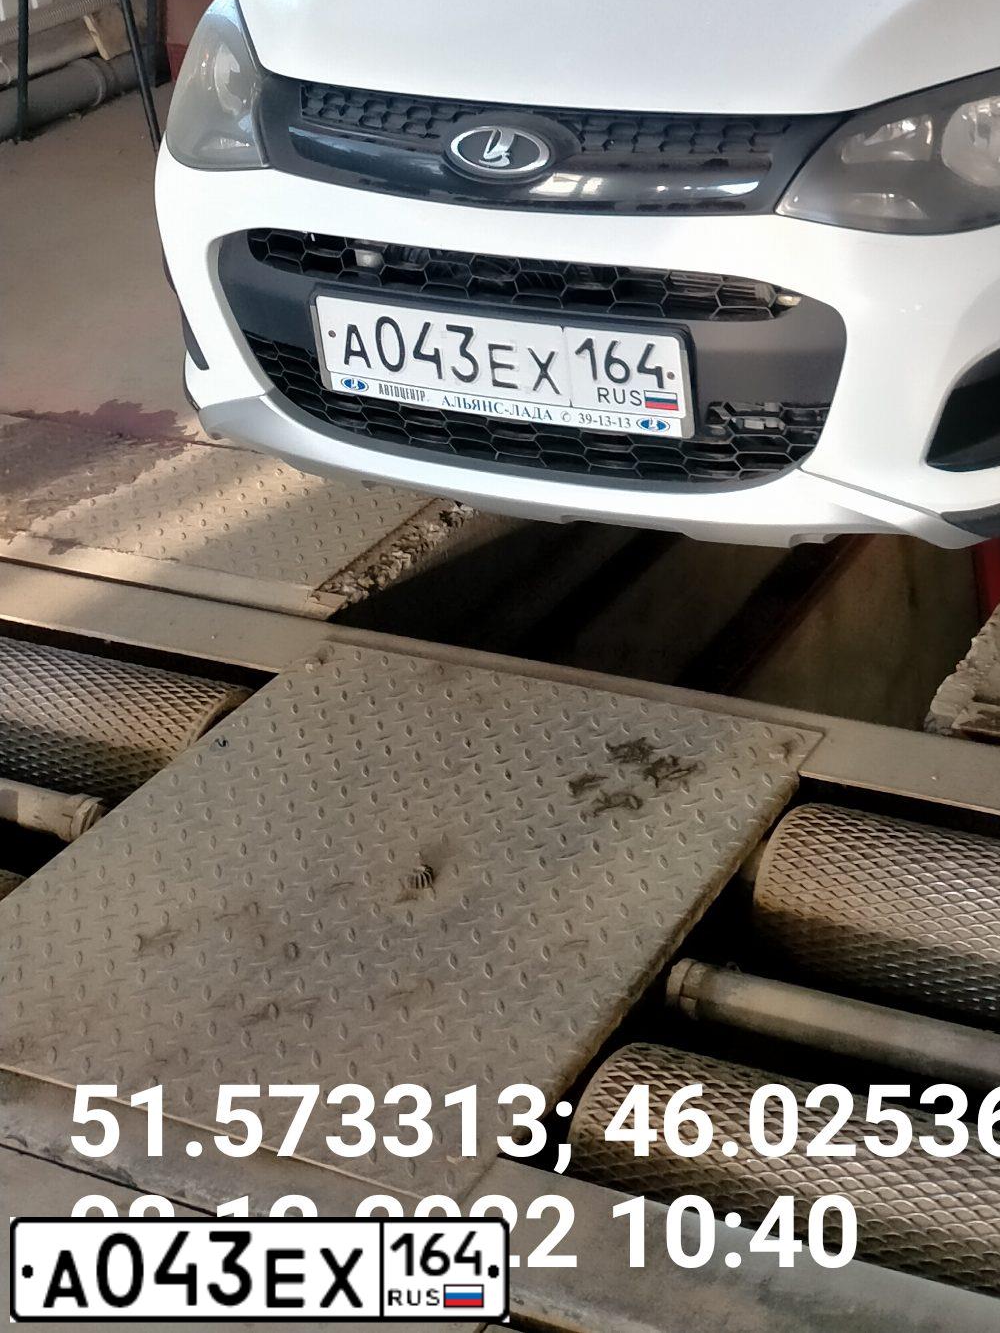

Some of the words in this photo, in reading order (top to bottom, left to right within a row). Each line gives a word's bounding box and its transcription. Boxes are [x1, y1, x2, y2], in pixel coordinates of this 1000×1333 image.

[343, 315, 561, 396] А043ЕХ
[574, 336, 665, 390] 164
[441, 395, 553, 421] АЛЬЯНС-ЛАДА
[578, 412, 632, 429] 39-13-13
[596, 386, 643, 407] RUS
